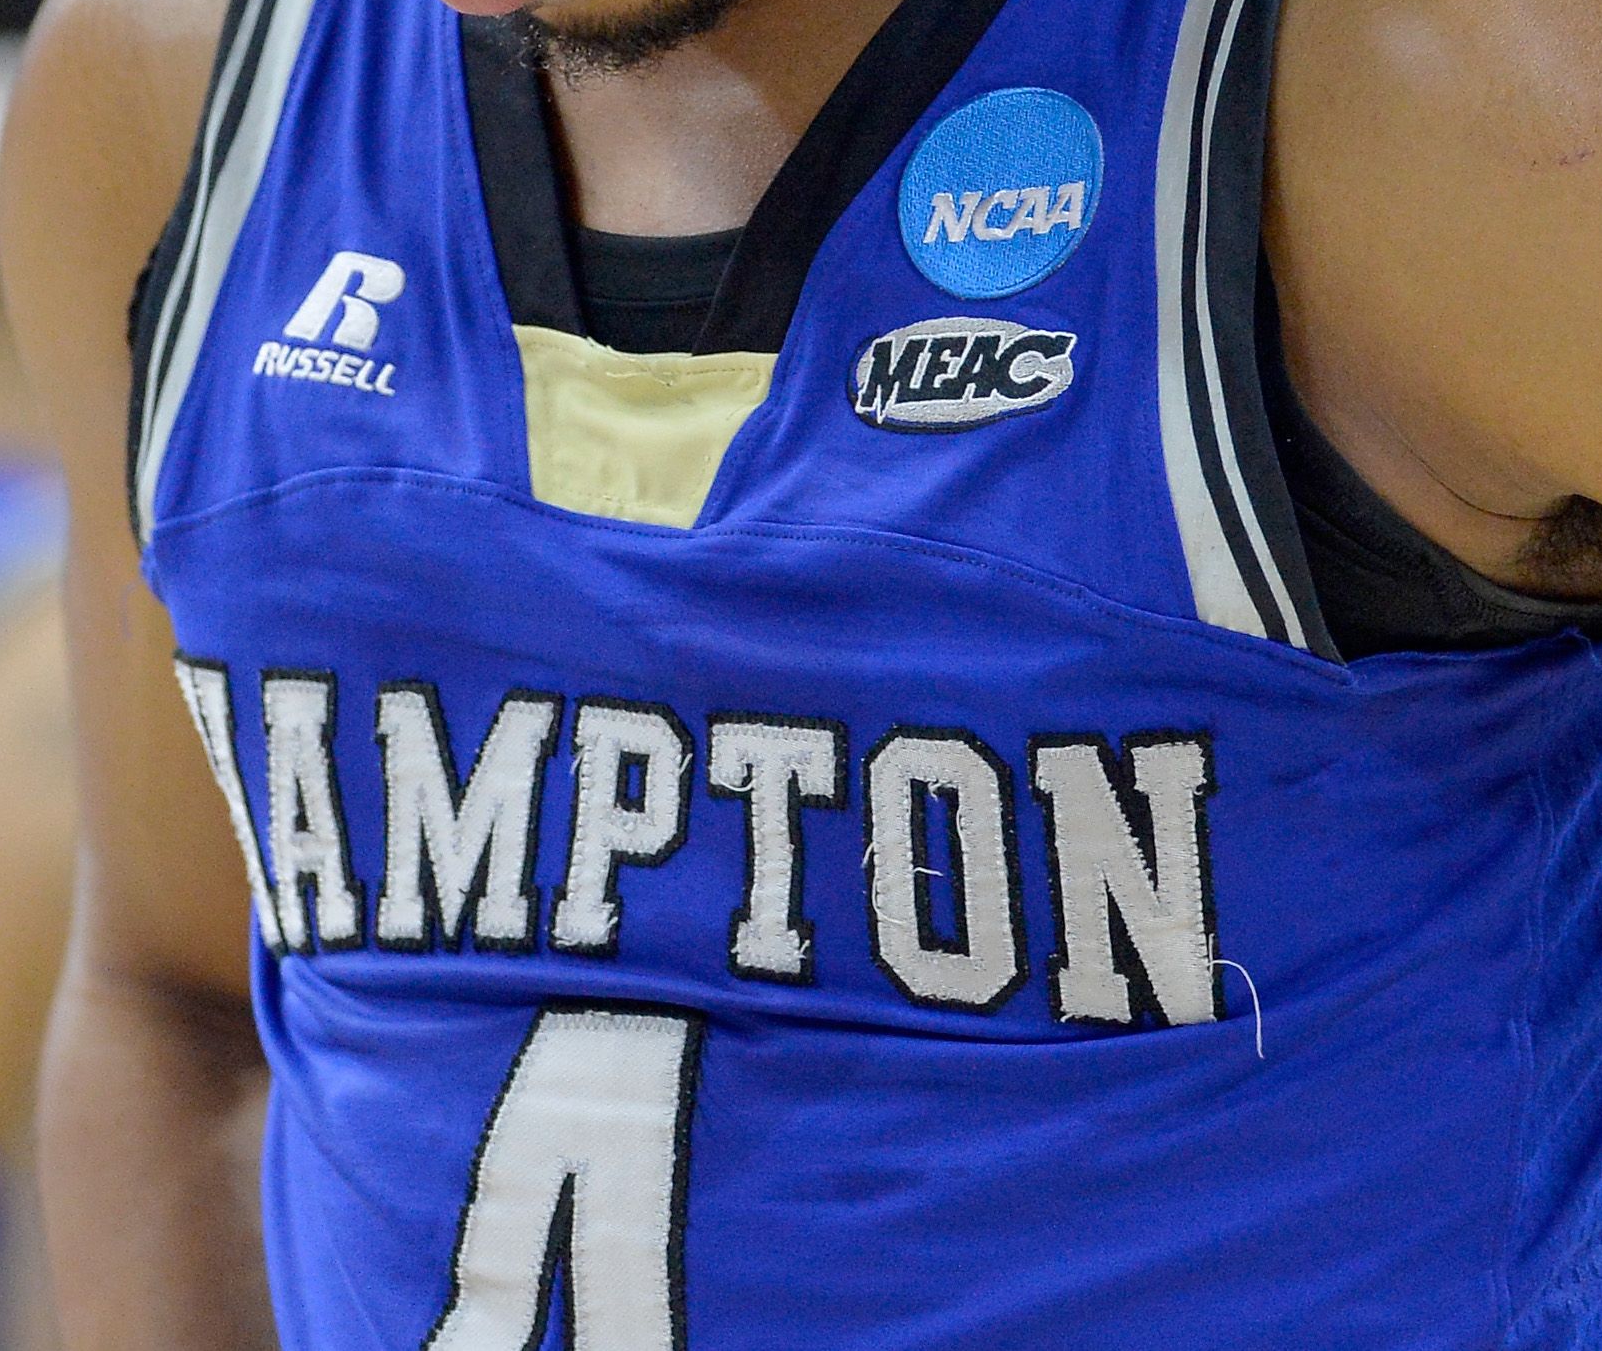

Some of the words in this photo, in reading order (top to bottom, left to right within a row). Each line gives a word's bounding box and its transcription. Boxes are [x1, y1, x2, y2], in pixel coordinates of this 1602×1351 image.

[922, 180, 1086, 245] NCAA
[251, 340, 397, 397] RUSSELL
[854, 329, 1078, 425] MEAC
